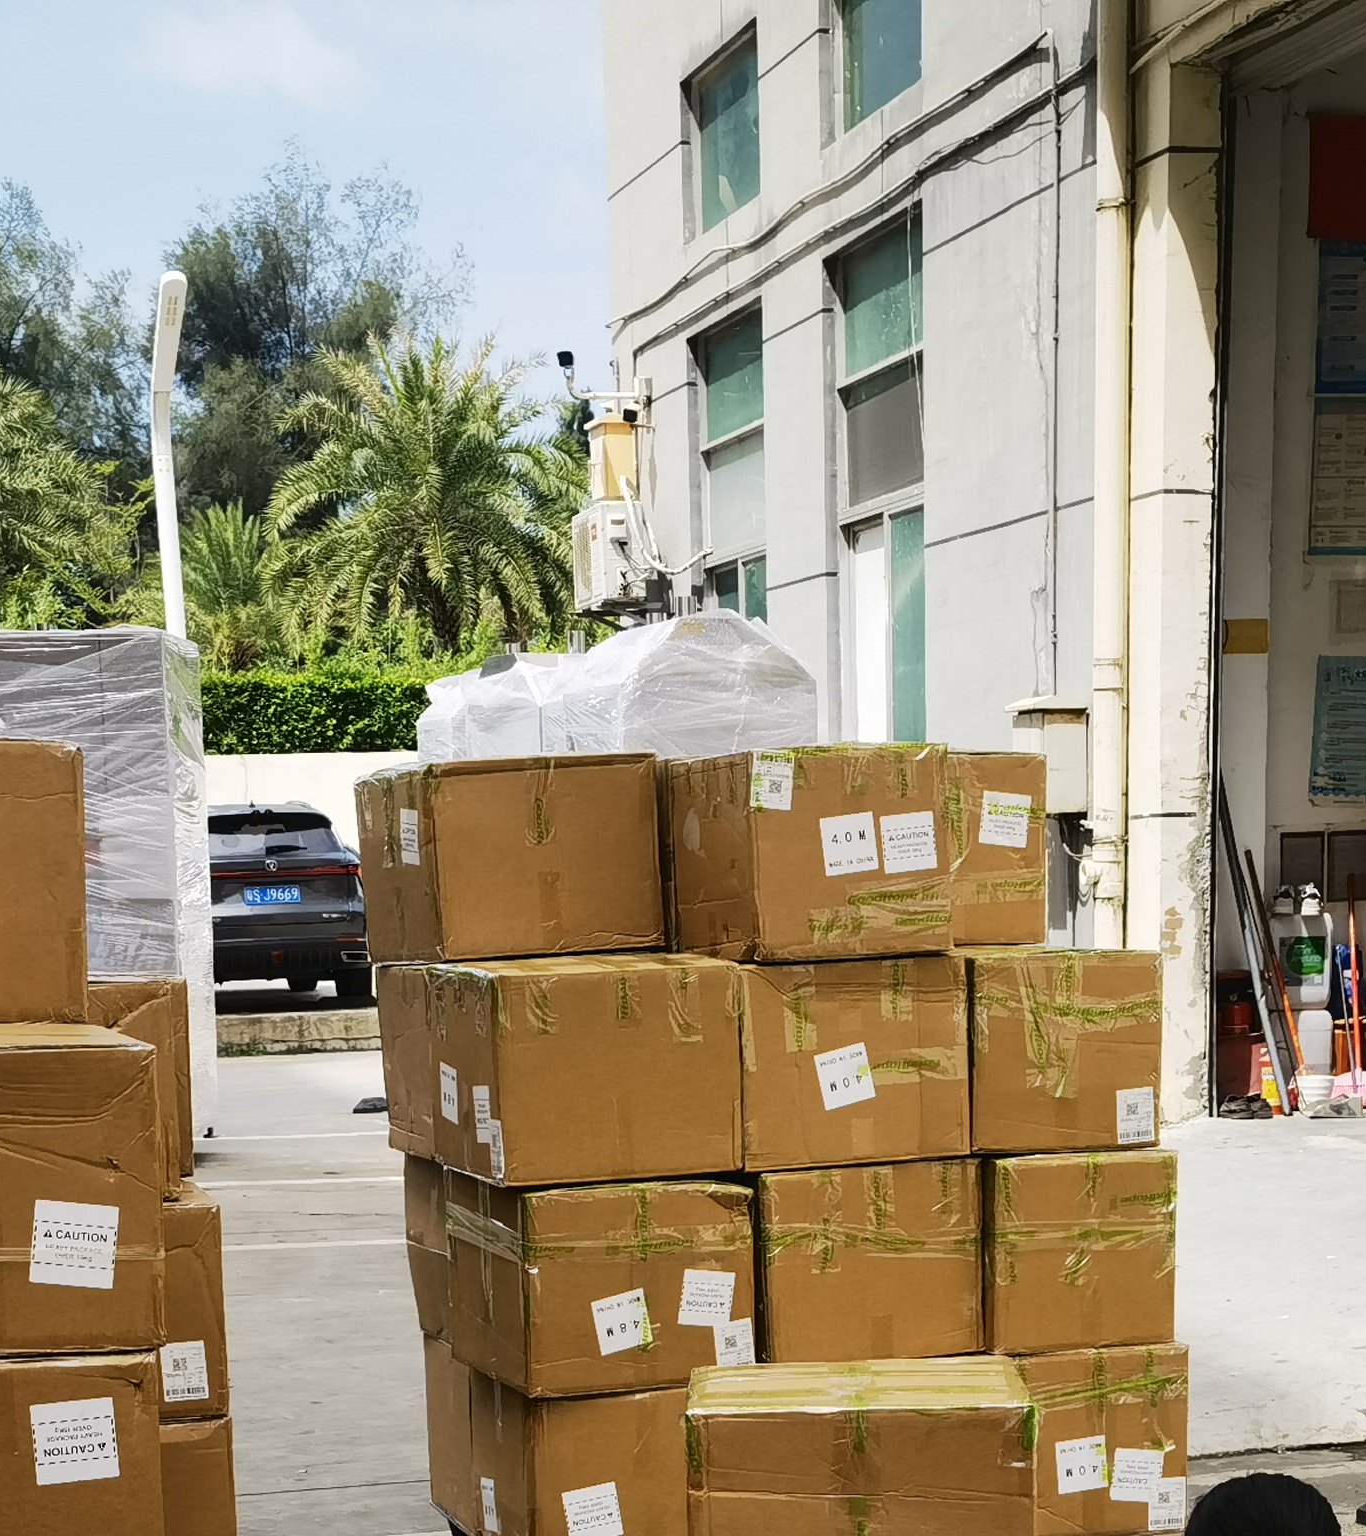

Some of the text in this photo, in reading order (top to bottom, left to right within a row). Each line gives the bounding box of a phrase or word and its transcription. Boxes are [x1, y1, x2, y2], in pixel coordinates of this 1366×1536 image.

[831, 831, 853, 844] 4.0
[55, 1229, 108, 1243] CAUTION
[43, 1443, 96, 1458] CAUTION
